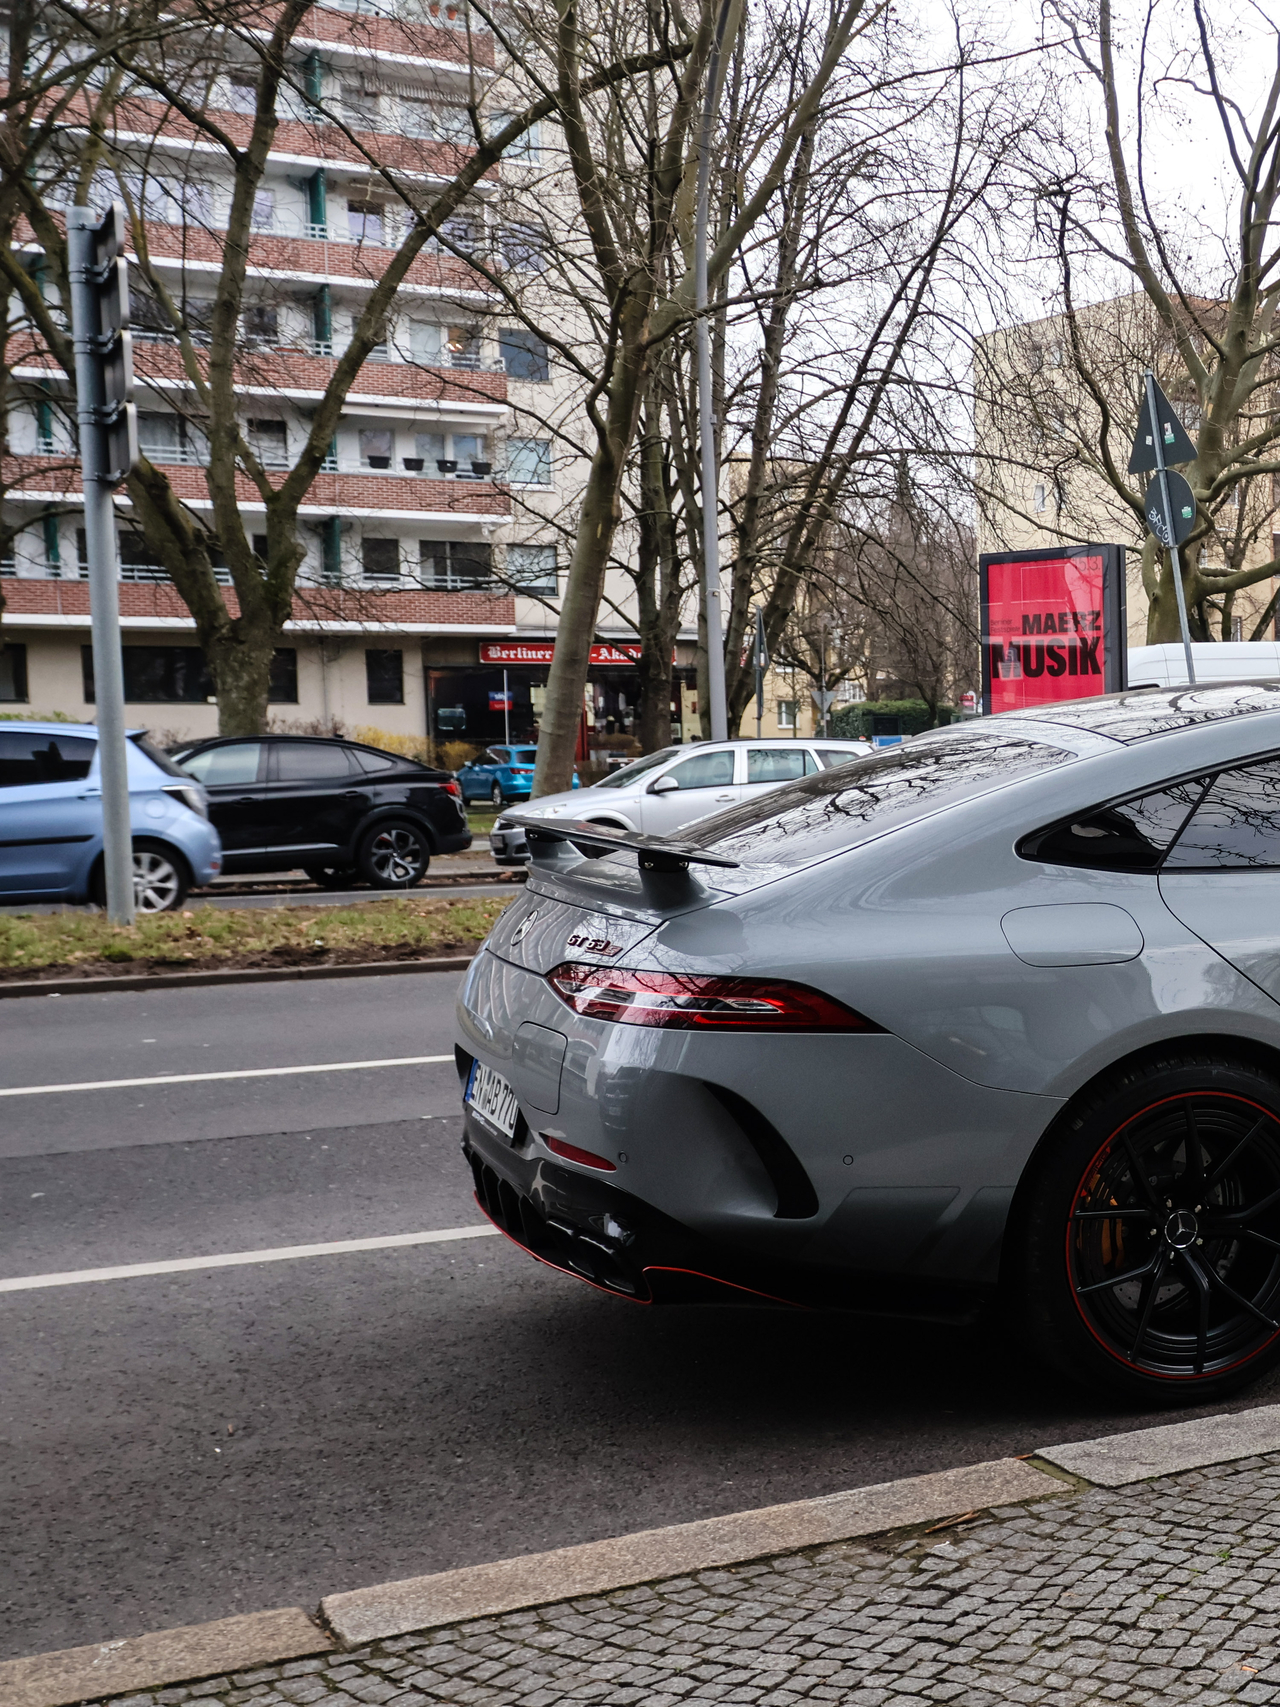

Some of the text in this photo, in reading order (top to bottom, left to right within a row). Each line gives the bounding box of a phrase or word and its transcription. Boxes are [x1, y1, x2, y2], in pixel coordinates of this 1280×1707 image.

[1022, 610, 1101, 635] MAERZ
[488, 646, 552, 659] Berliner
[991, 636, 1102, 679] MUSIK
